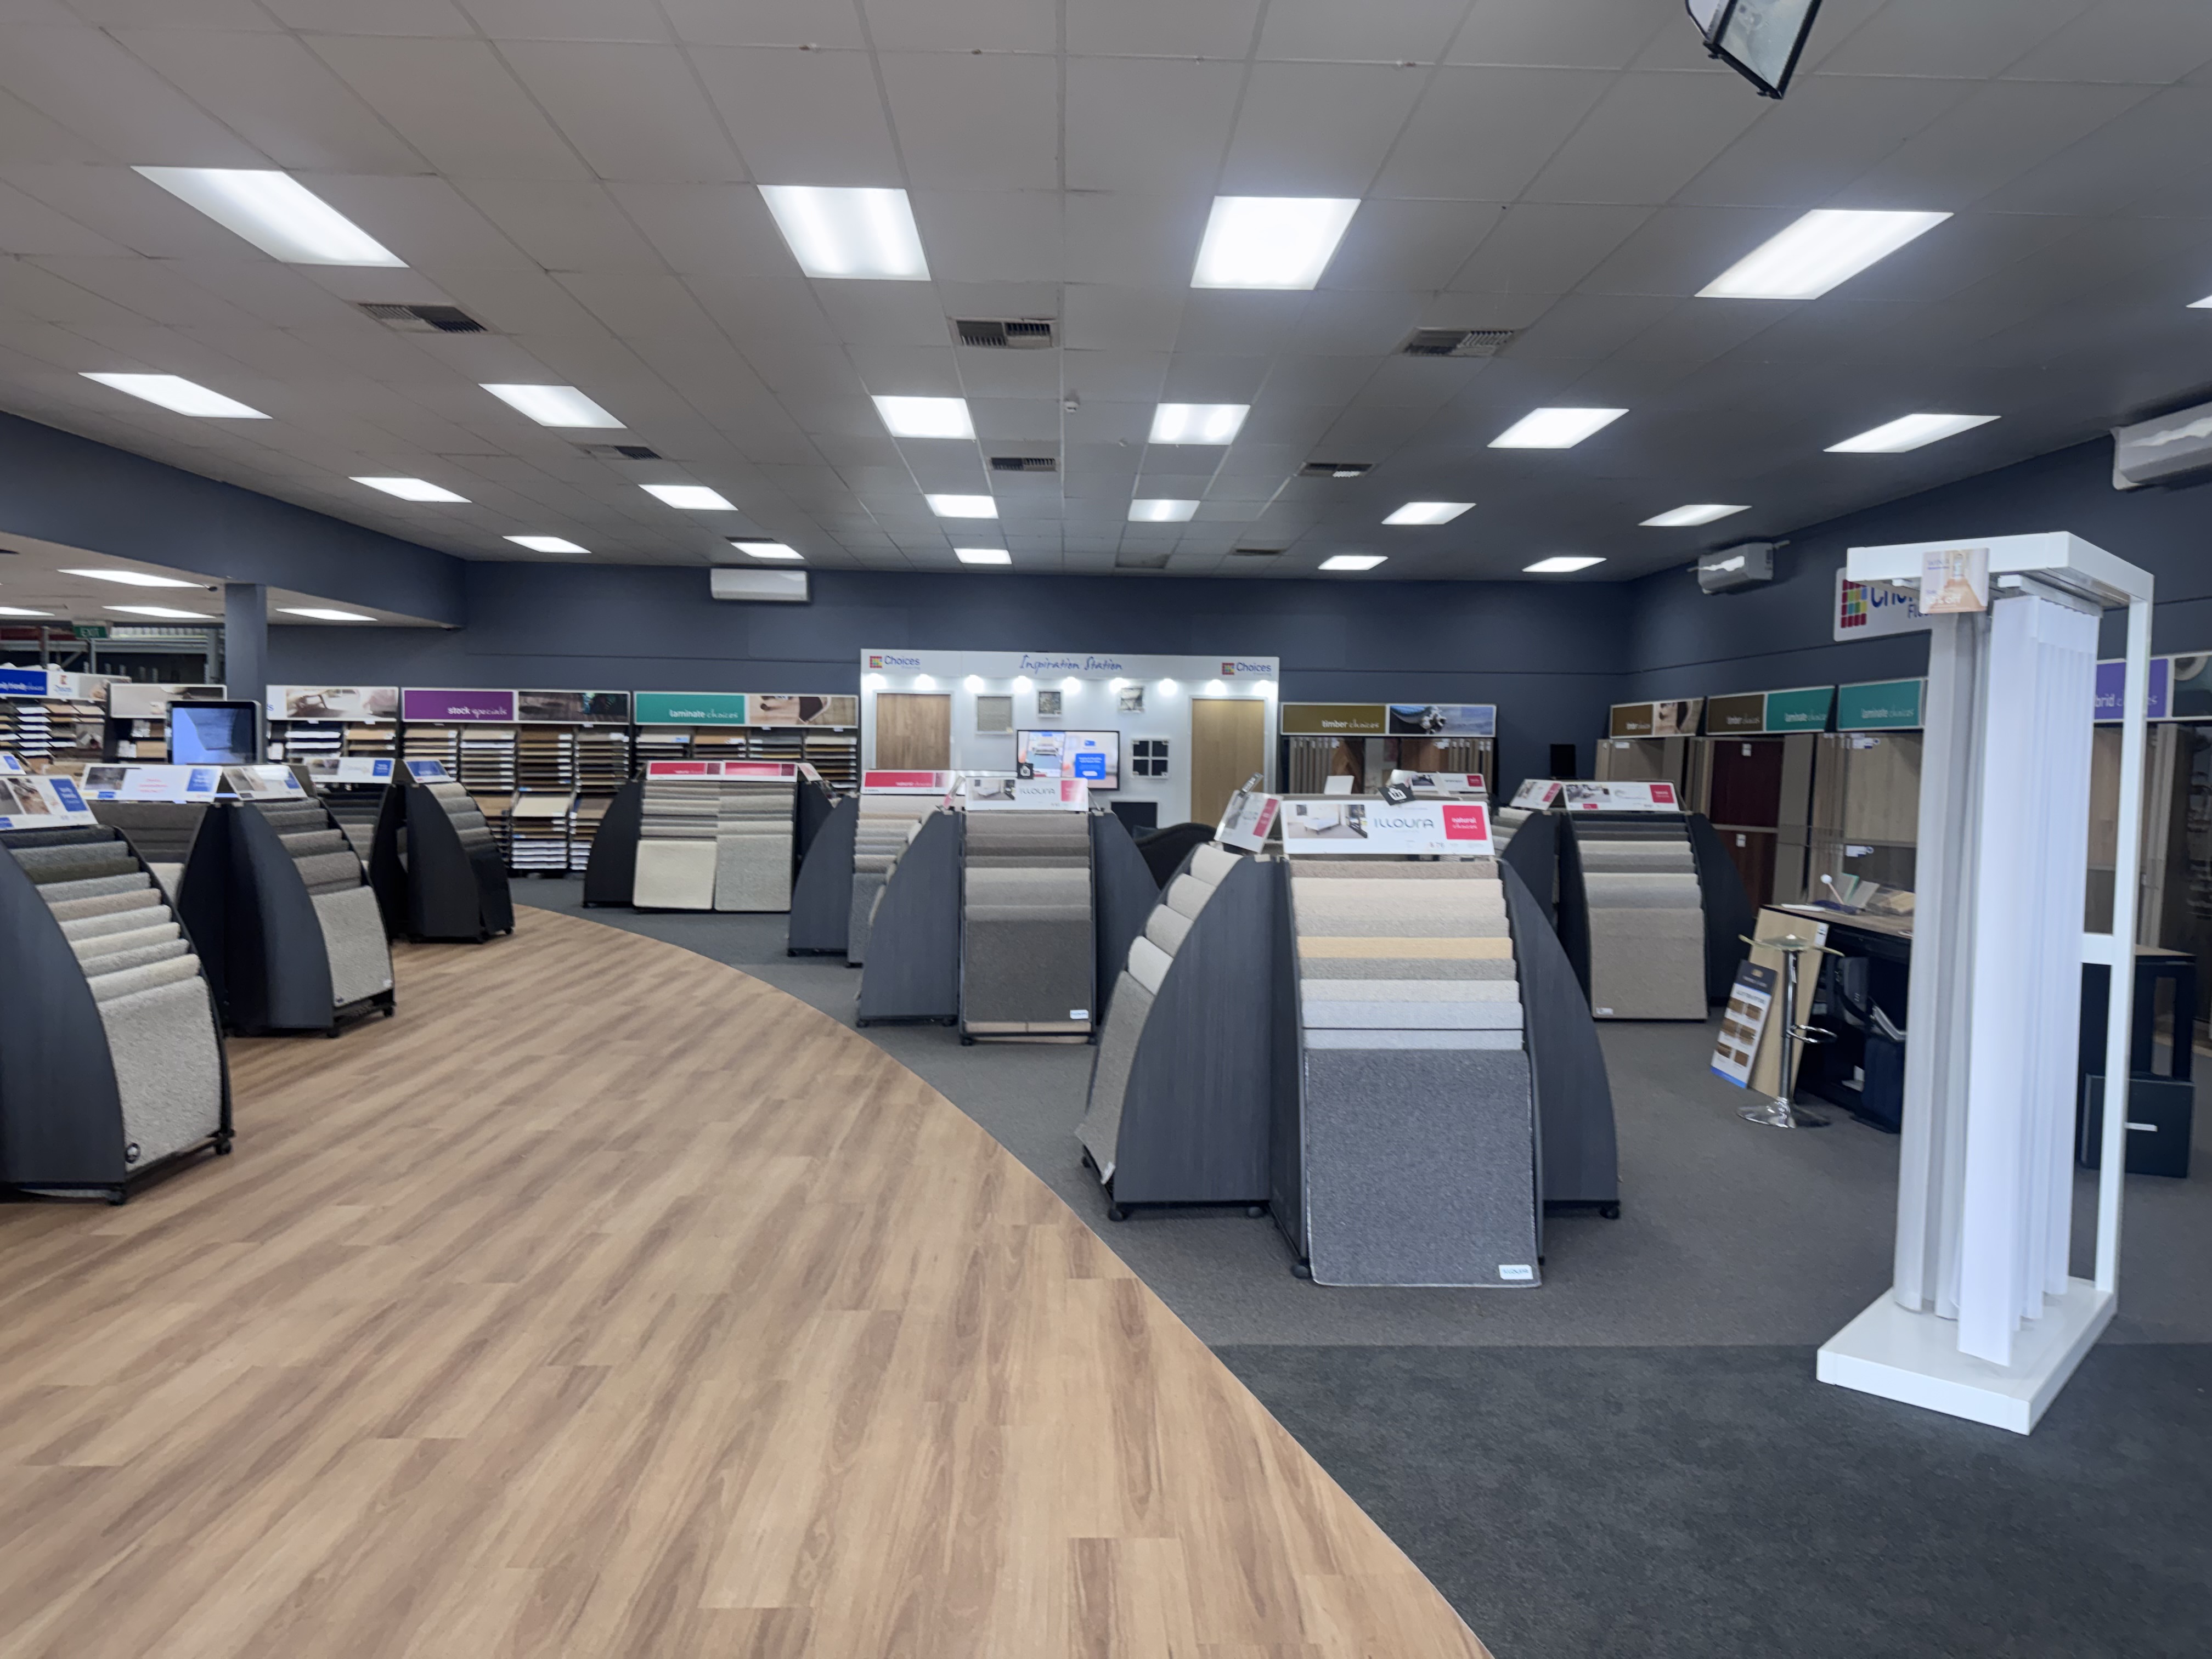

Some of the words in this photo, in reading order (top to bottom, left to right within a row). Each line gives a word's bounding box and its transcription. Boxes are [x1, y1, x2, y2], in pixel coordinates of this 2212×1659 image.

[80, 627, 100, 637] EXIT
[884, 655, 921, 665] Choices
[1020, 654, 1080, 674] Inspiration
[1084, 656, 1122, 670] Station
[1237, 662, 1272, 672] Choices
[2095, 693, 2115, 707] brid
[447, 706, 470, 714] stock
[472, 706, 507, 719] specials
[669, 709, 705, 718] laminate
[706, 708, 738, 718] choices
[1322, 720, 1348, 728] timber
[1349, 718, 1380, 729] choices
